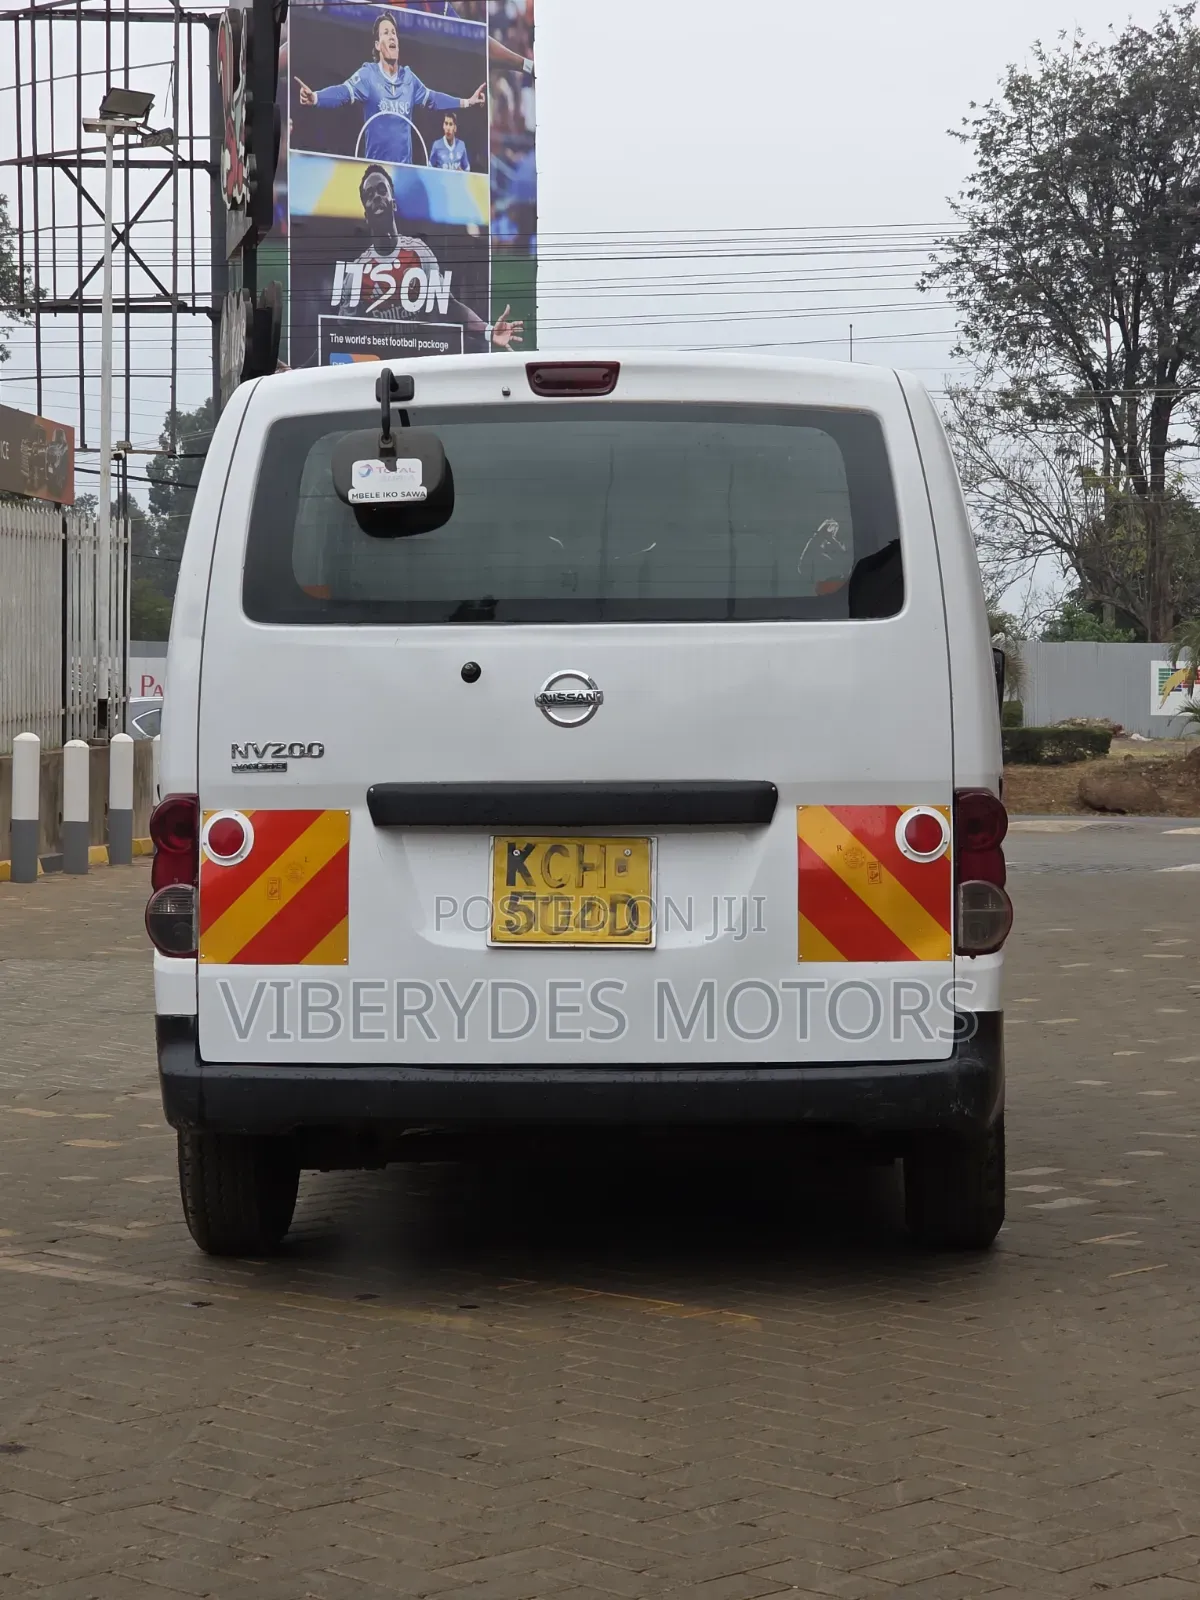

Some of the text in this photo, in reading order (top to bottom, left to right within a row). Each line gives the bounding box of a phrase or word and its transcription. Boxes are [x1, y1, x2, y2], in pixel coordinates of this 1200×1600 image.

[331, 260, 452, 315] IT'S ON
[329, 333, 449, 352] The world's best football package
[351, 492, 380, 500] MBELE
[541, 692, 597, 703] NISSAN
[231, 741, 325, 760] NV200
[506, 842, 607, 889] KCH
